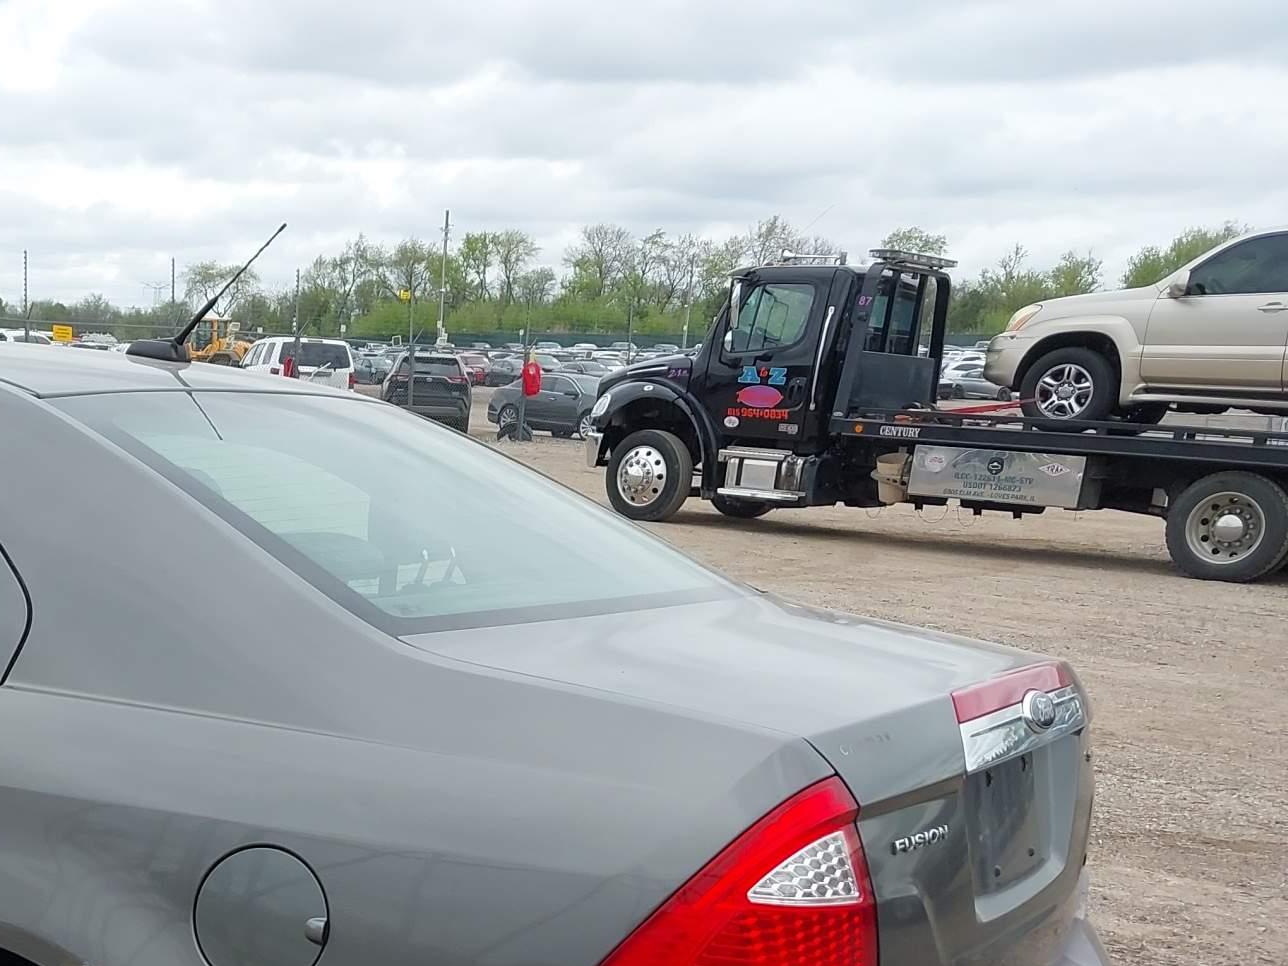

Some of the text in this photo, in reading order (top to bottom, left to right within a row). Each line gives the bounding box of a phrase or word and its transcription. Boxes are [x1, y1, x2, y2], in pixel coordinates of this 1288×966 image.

[858, 295, 873, 306] 87
[737, 366, 760, 384] A
[768, 367, 788, 385] Z
[879, 425, 921, 438] CENTURY
[893, 824, 949, 853] FUSION
